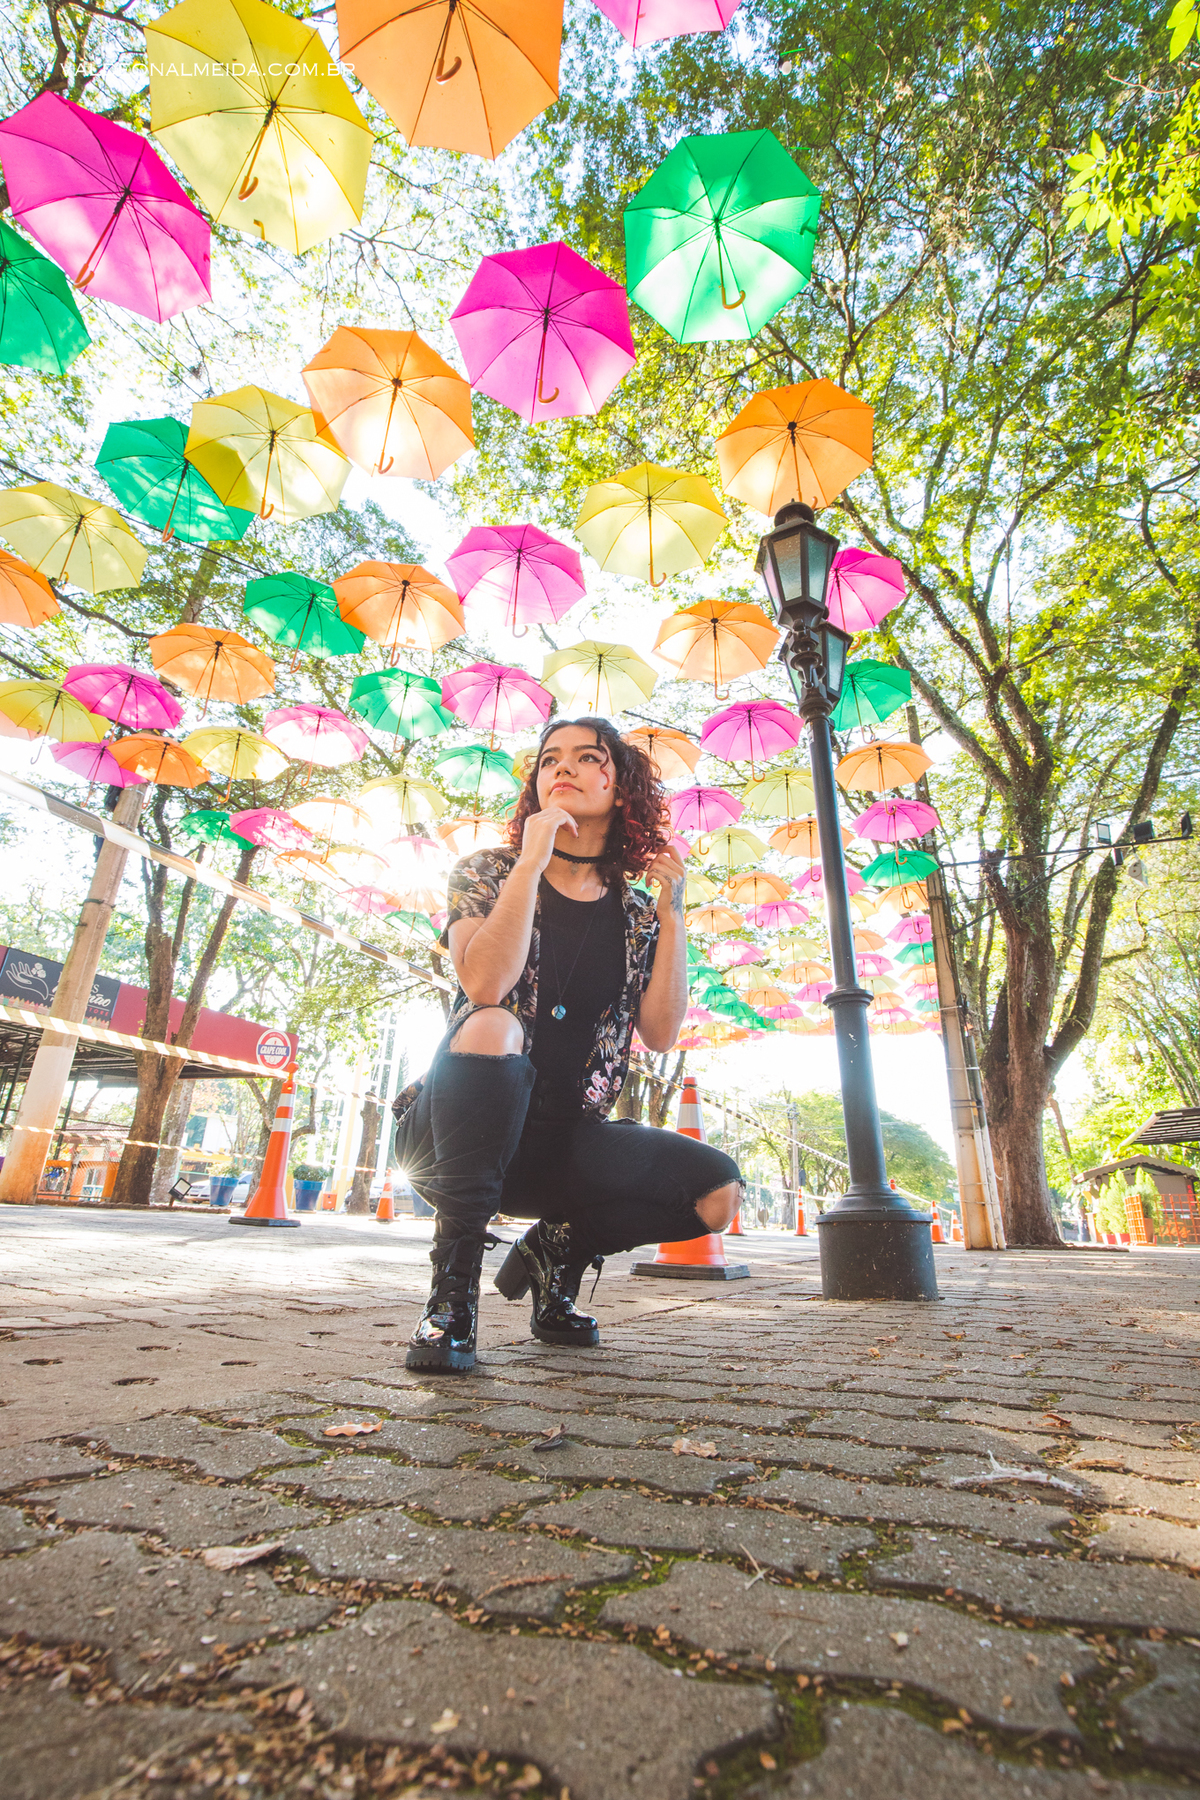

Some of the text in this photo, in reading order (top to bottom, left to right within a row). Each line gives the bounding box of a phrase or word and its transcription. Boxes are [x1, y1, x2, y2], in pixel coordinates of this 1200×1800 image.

[88, 1007, 109, 1017] TORE
[260, 1045, 287, 1056] GRAPE COOL
